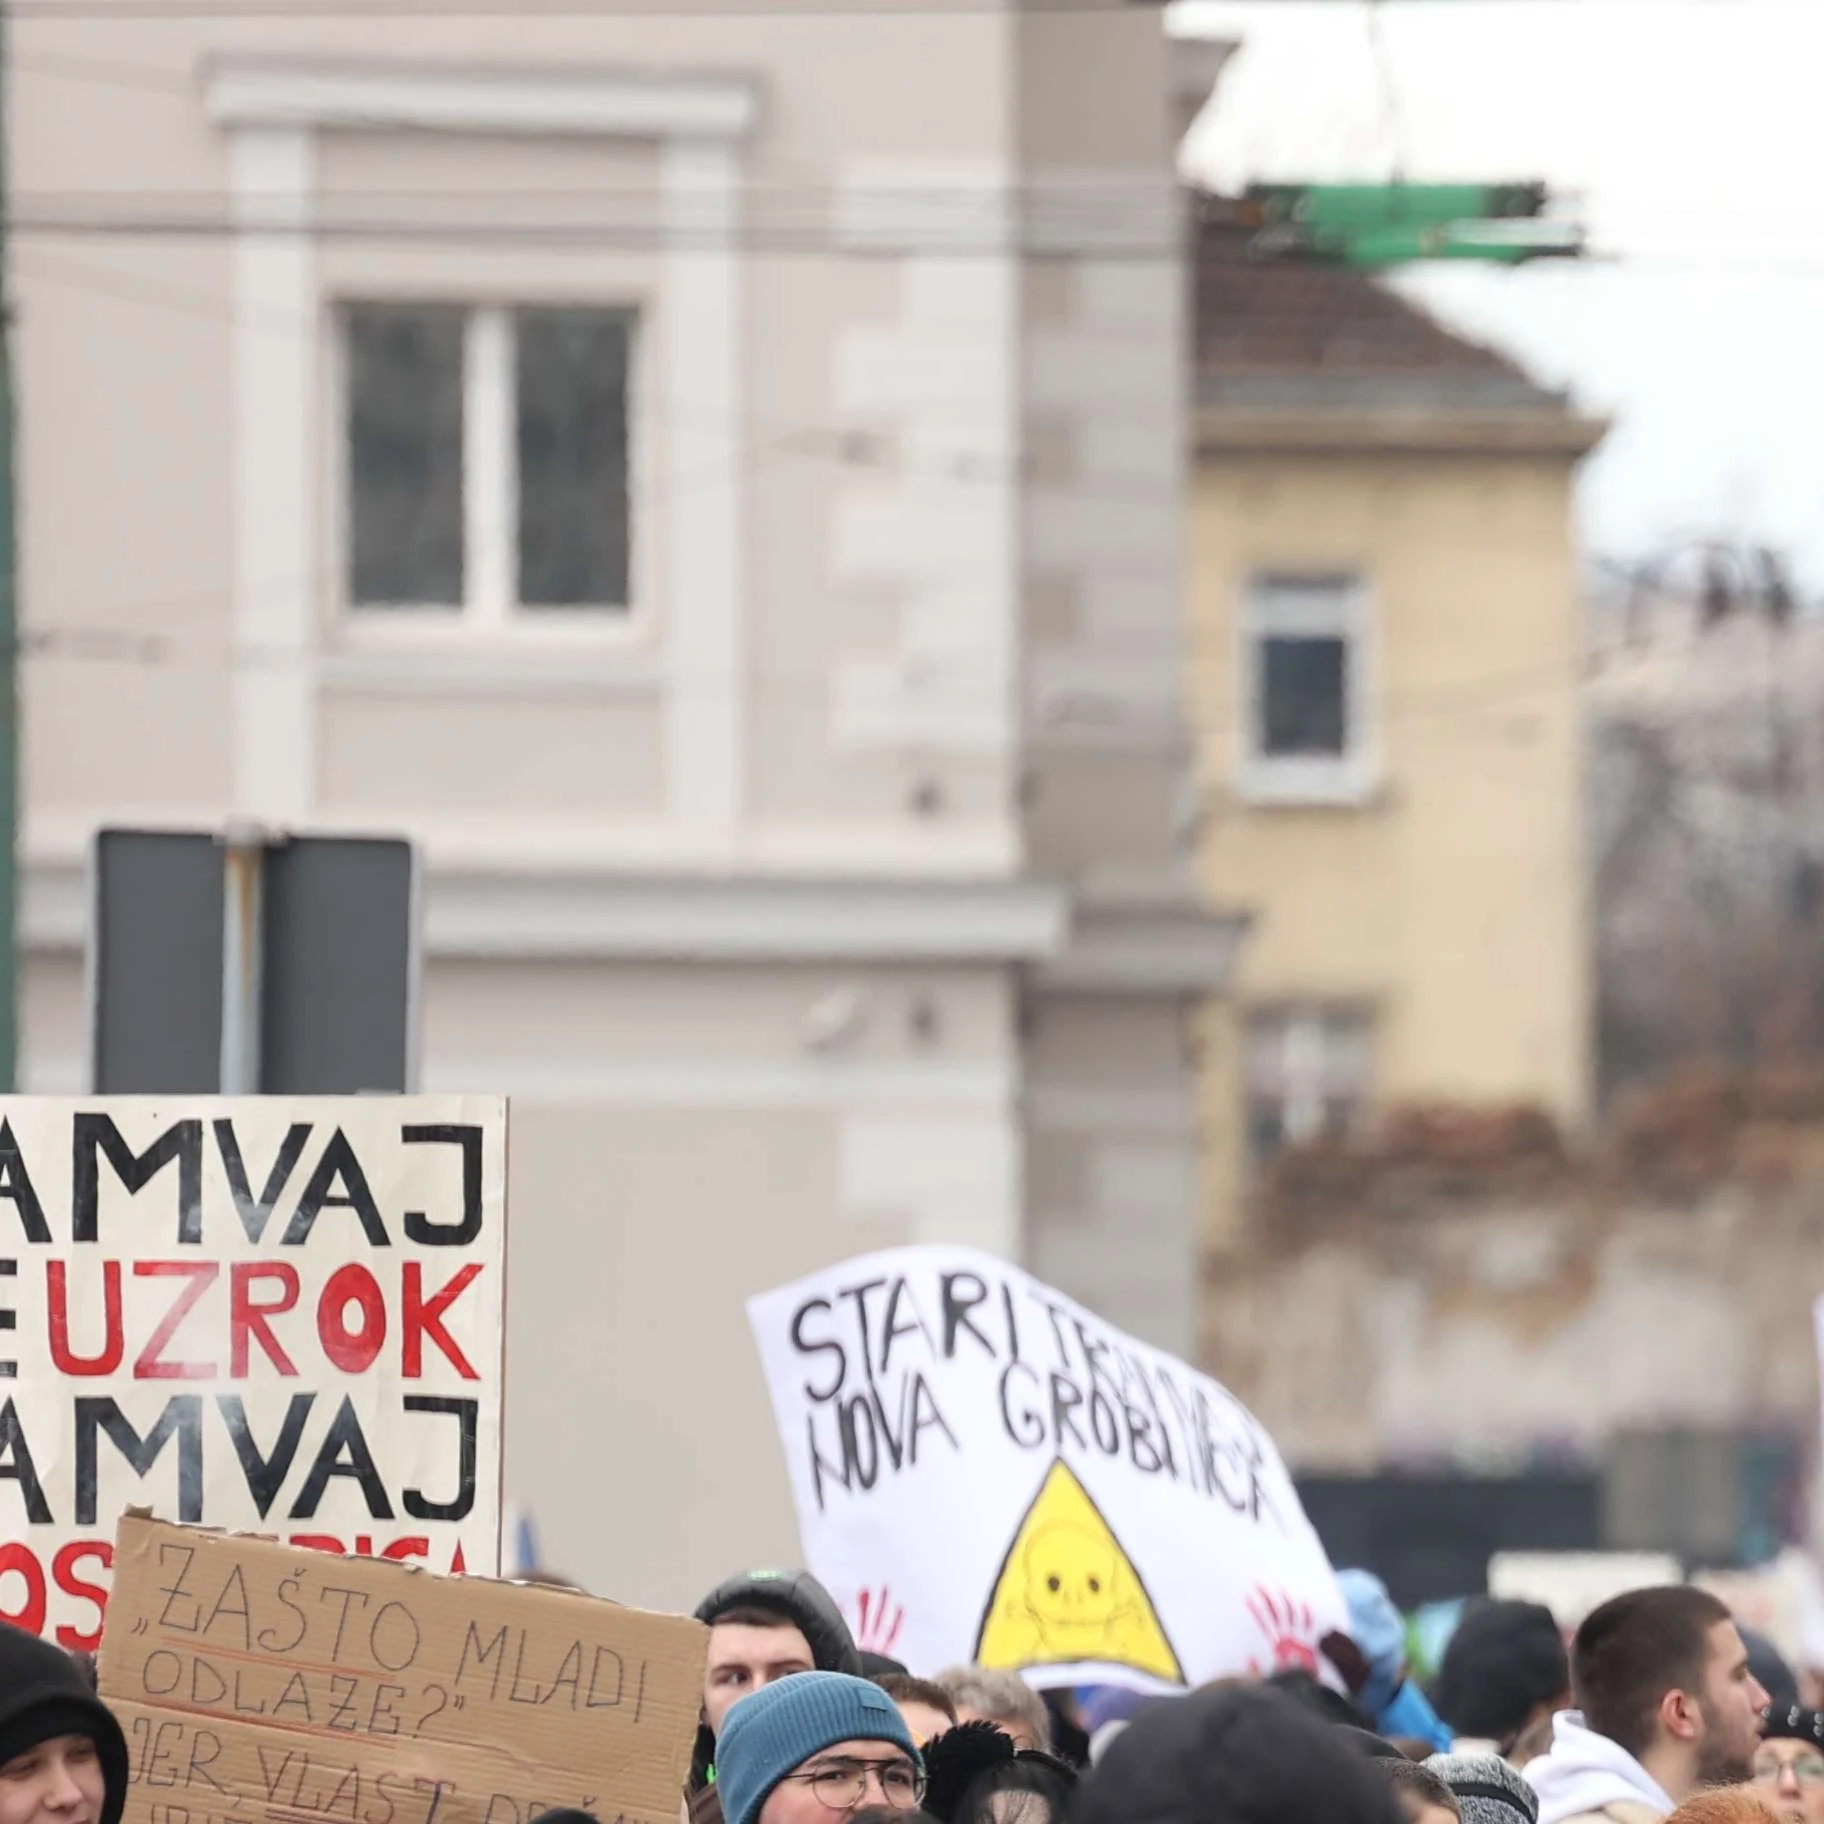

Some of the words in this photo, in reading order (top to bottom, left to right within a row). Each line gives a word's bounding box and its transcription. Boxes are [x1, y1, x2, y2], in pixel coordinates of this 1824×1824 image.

[46, 1259, 486, 1380] UZROK
[789, 1271, 1018, 1402] STARI
[806, 1367, 960, 1516] NOVA
[454, 1620, 649, 1725] MLADI
